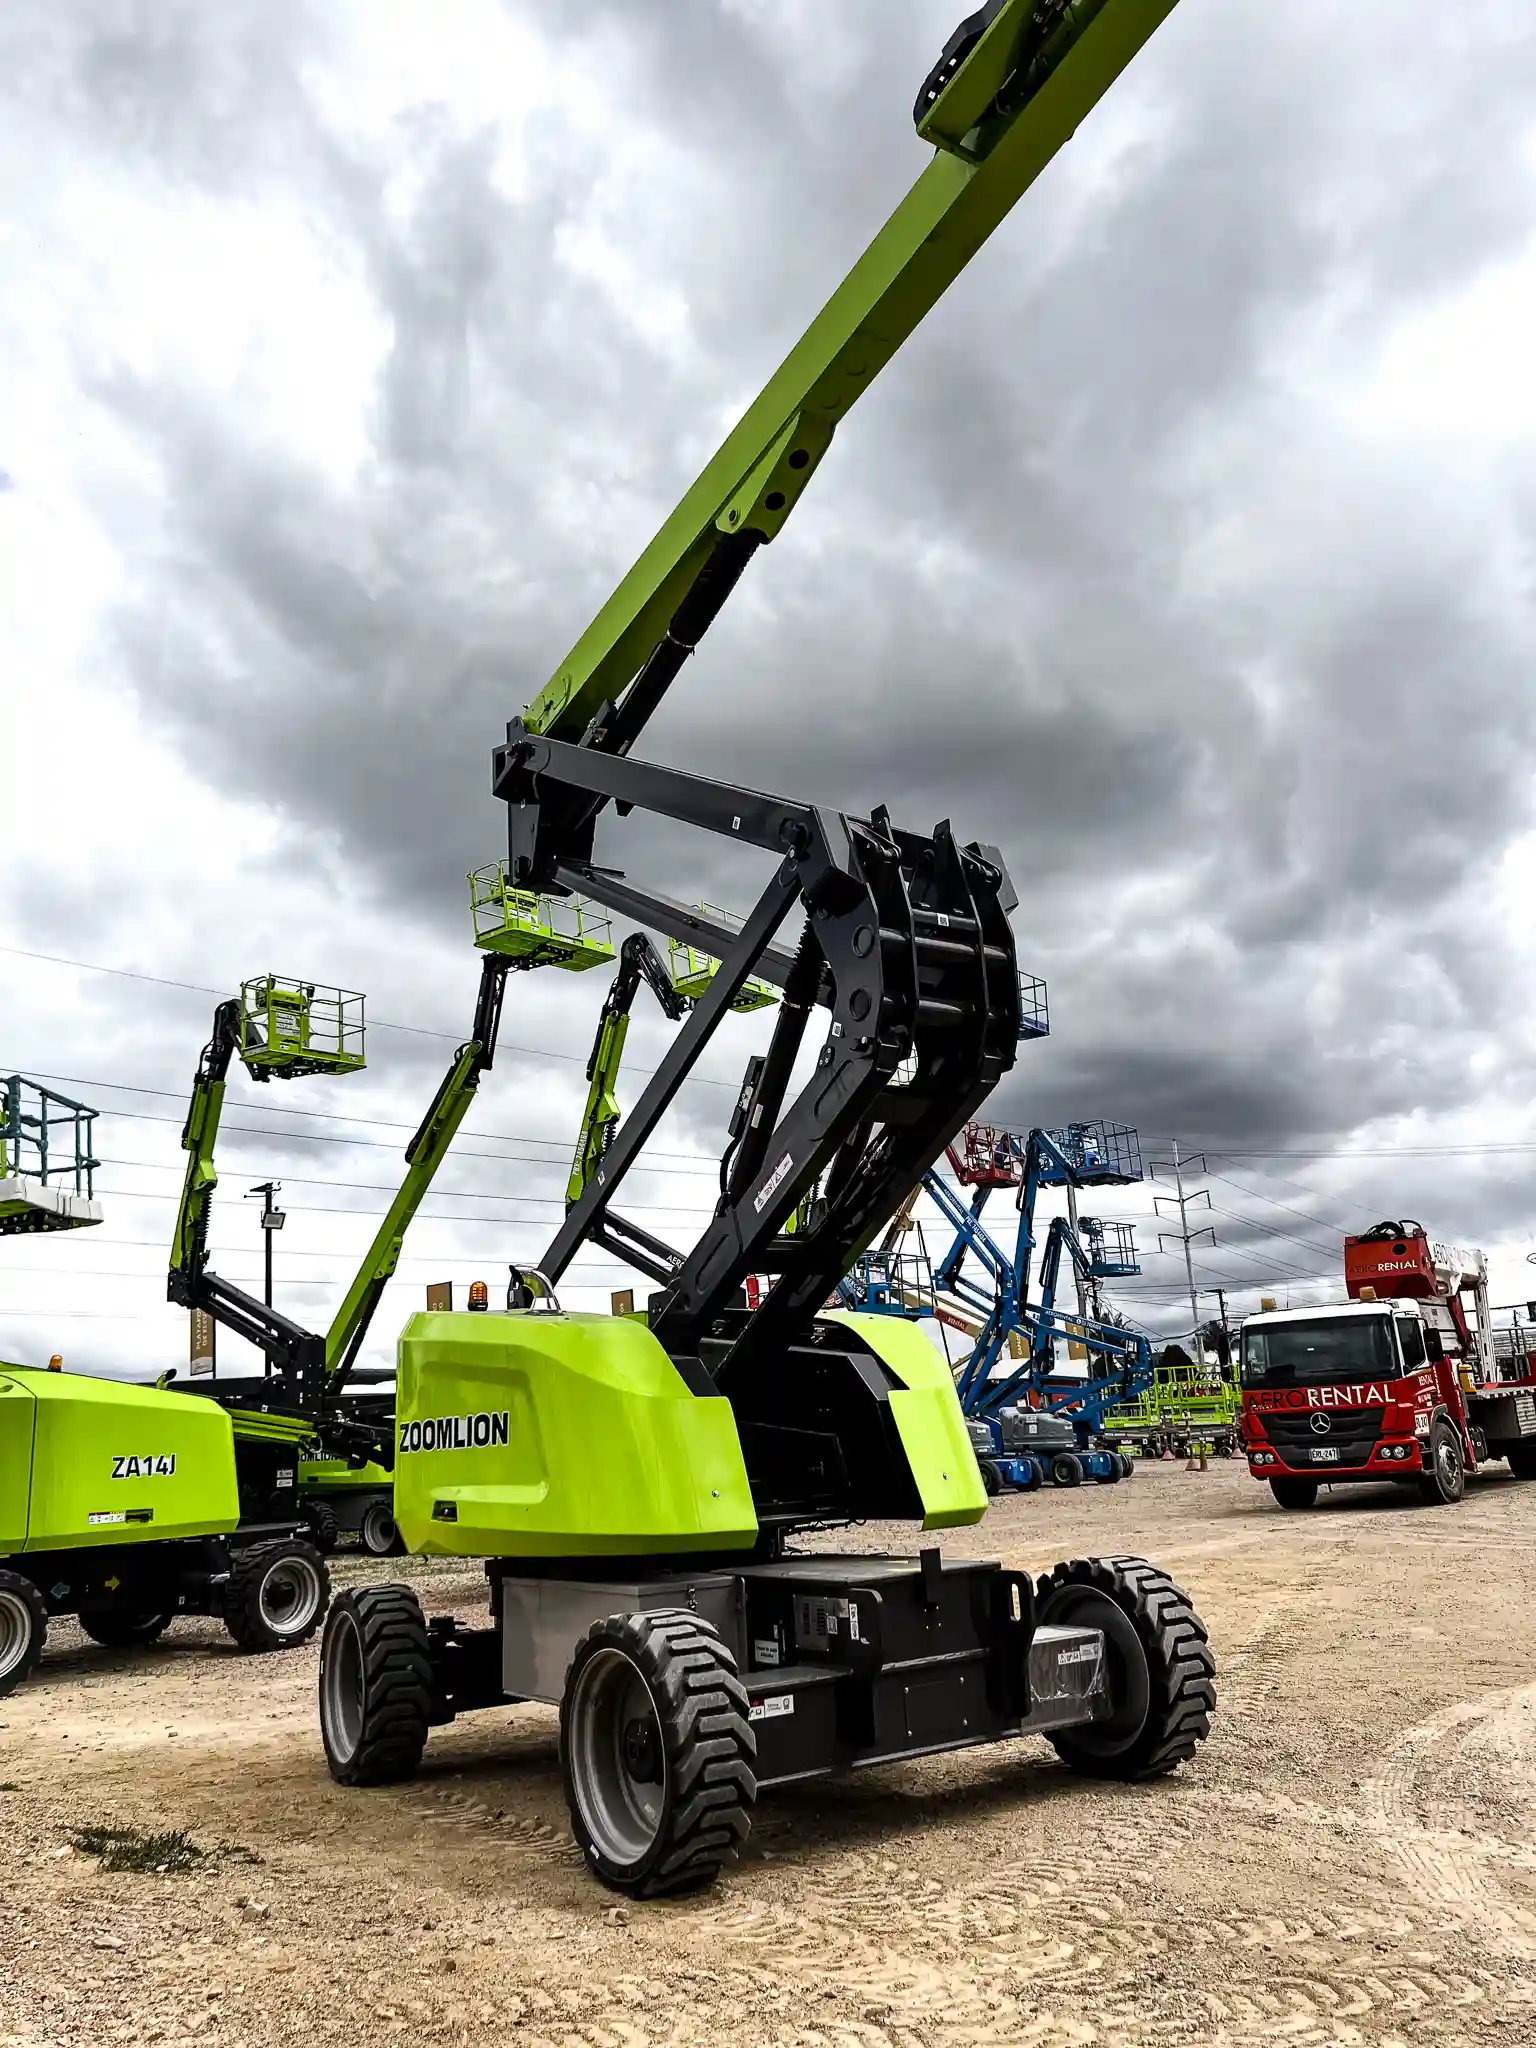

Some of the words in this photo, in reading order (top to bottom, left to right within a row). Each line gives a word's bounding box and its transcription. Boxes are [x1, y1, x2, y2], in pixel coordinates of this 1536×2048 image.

[1249, 1384, 1396, 1408] AERORENTAL
[399, 1411, 510, 1453] ZOOMLION
[111, 1453, 177, 1480] ZA14J
